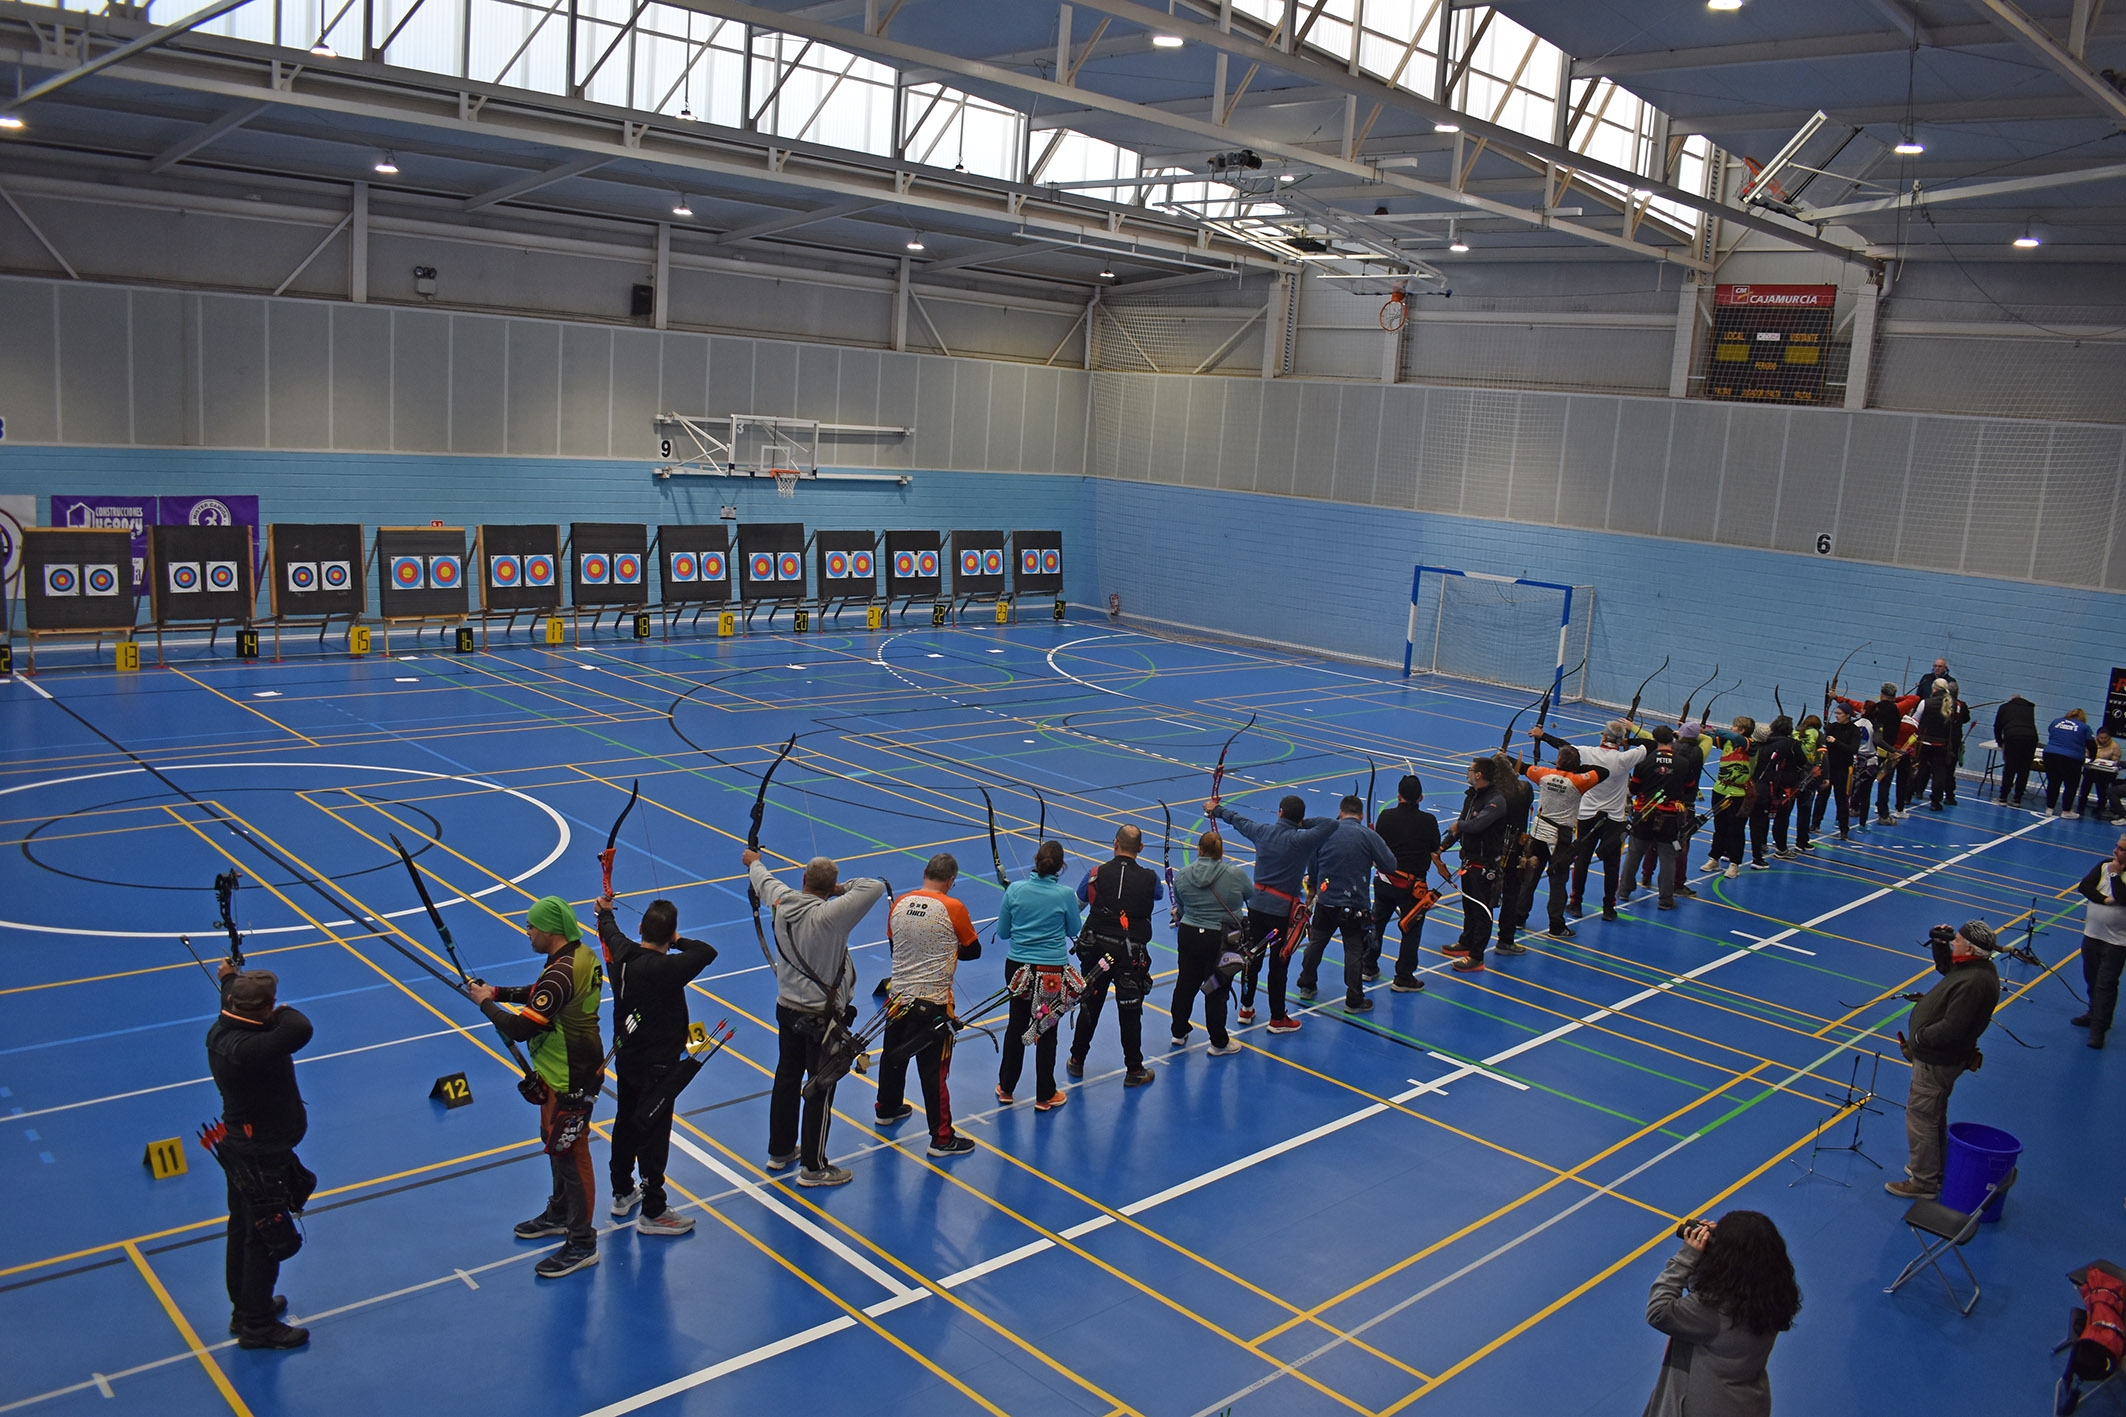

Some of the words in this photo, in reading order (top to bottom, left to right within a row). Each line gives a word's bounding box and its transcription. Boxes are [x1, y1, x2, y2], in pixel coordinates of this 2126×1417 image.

[1749, 295, 1818, 304] CAJAMURCIA
[1724, 332, 1745, 340] LOCAL
[661, 440, 672, 458] 9
[95, 507, 143, 517] CONSTRUCCIONES
[1817, 533, 1831, 555] 6
[868, 609, 881, 626] 21
[933, 606, 945, 623] 22
[996, 604, 1008, 621] 23
[1055, 602, 1065, 618] 24
[552, 621, 563, 640] 17
[639, 617, 649, 636] 18
[723, 615, 733, 633] 19
[795, 612, 808, 631] 20
[244, 634, 257, 655] 14
[357, 630, 369, 651] 15
[0, 648, 10, 672] 2
[125, 645, 138, 668] 13
[443, 1078, 470, 1100] 12
[157, 1144, 180, 1174] 11
